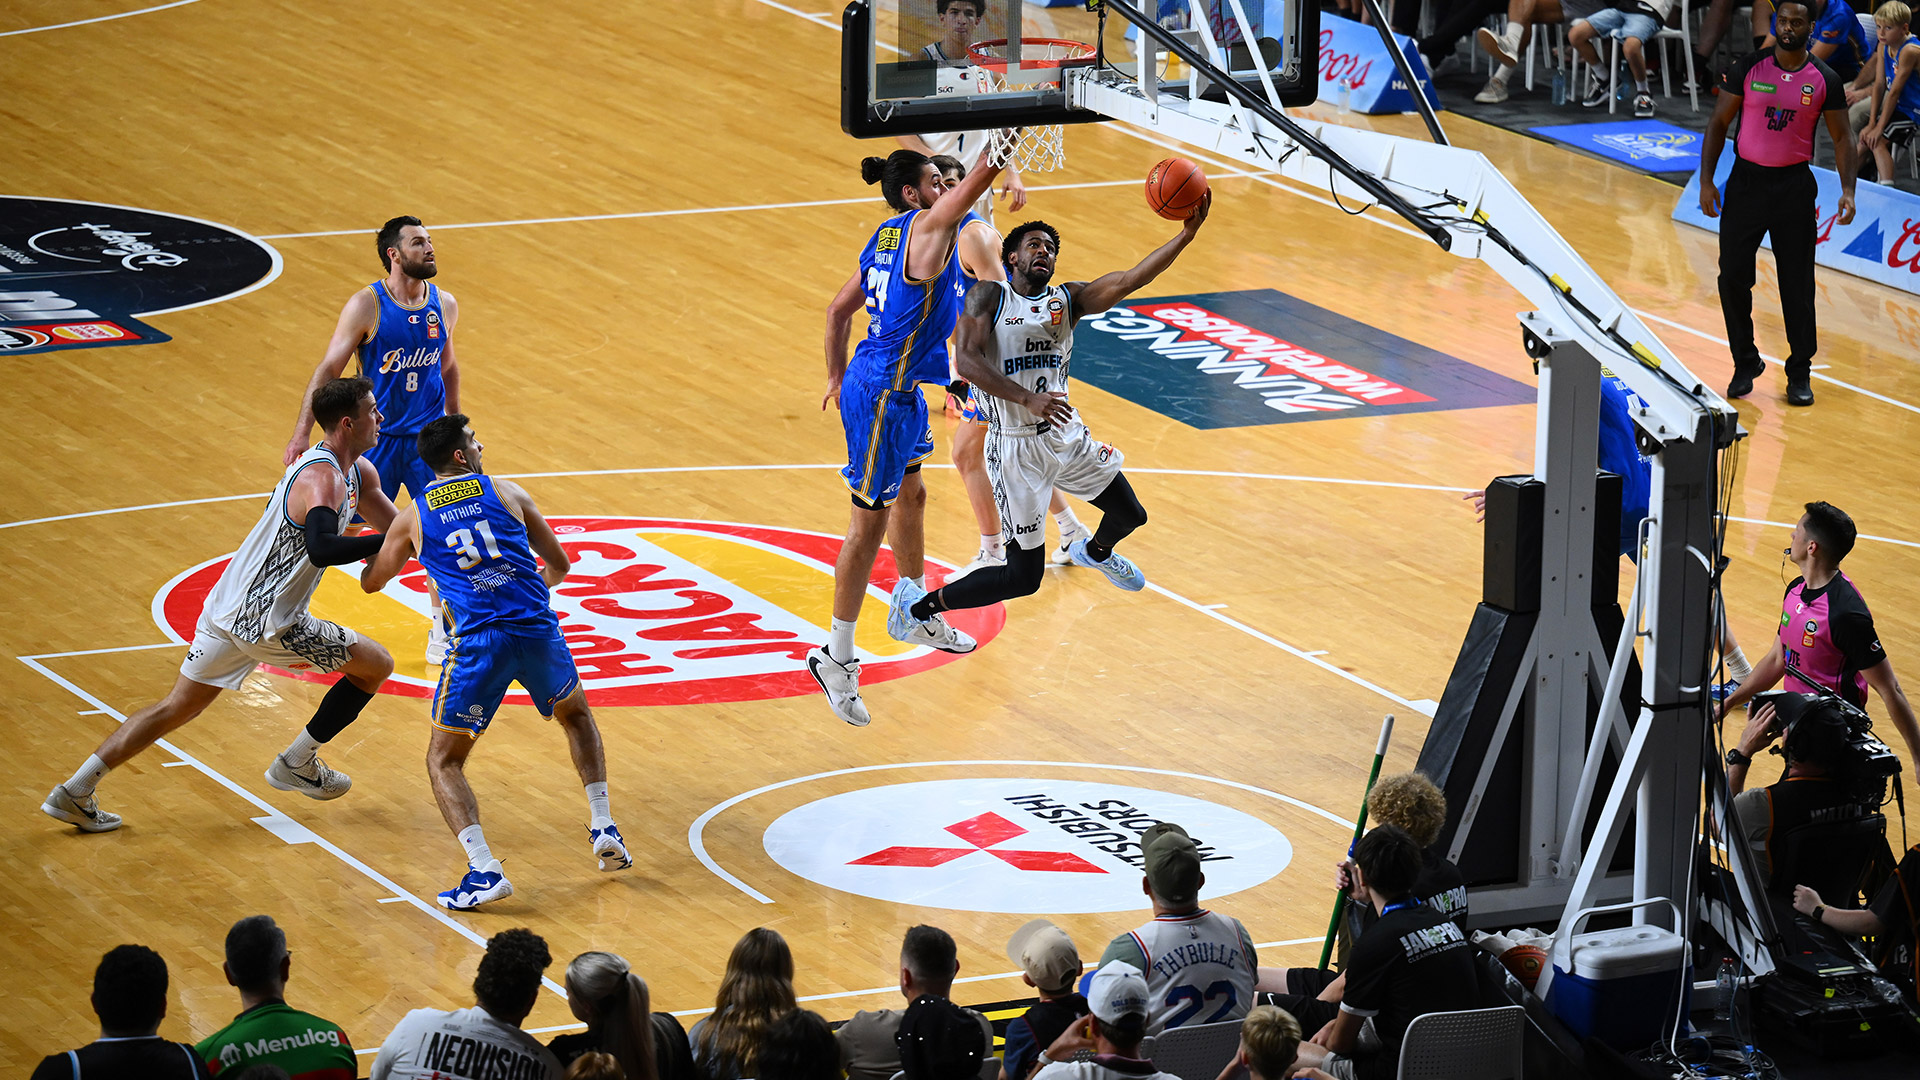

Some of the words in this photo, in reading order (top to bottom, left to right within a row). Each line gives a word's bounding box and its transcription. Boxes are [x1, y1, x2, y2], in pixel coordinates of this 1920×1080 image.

[1391, 80, 1427, 91] HAT
[1767, 118, 1788, 132] CUP
[957, 133, 965, 152] 1
[865, 266, 890, 312] 24
[1005, 317, 1024, 325] SIXT
[1025, 338, 1051, 352] bnz
[1153, 308, 1403, 399] warehouse
[379, 347, 441, 374] Bullets
[405, 372, 418, 392] 8
[1035, 376, 1047, 393] 8
[427, 480, 478, 498] NATIONAL
[431, 487, 478, 506] STORAGE
[440, 502, 483, 524] MATHIAS
[1016, 523, 1038, 535] bnz
[445, 519, 502, 570] 31
[1004, 794, 1147, 872] TSUBISHI
[1153, 942, 1239, 980] THYBULLE
[1164, 980, 1237, 1030] 22
[244, 1028, 341, 1058] Menulog
[423, 1032, 547, 1080] NEOVISION
